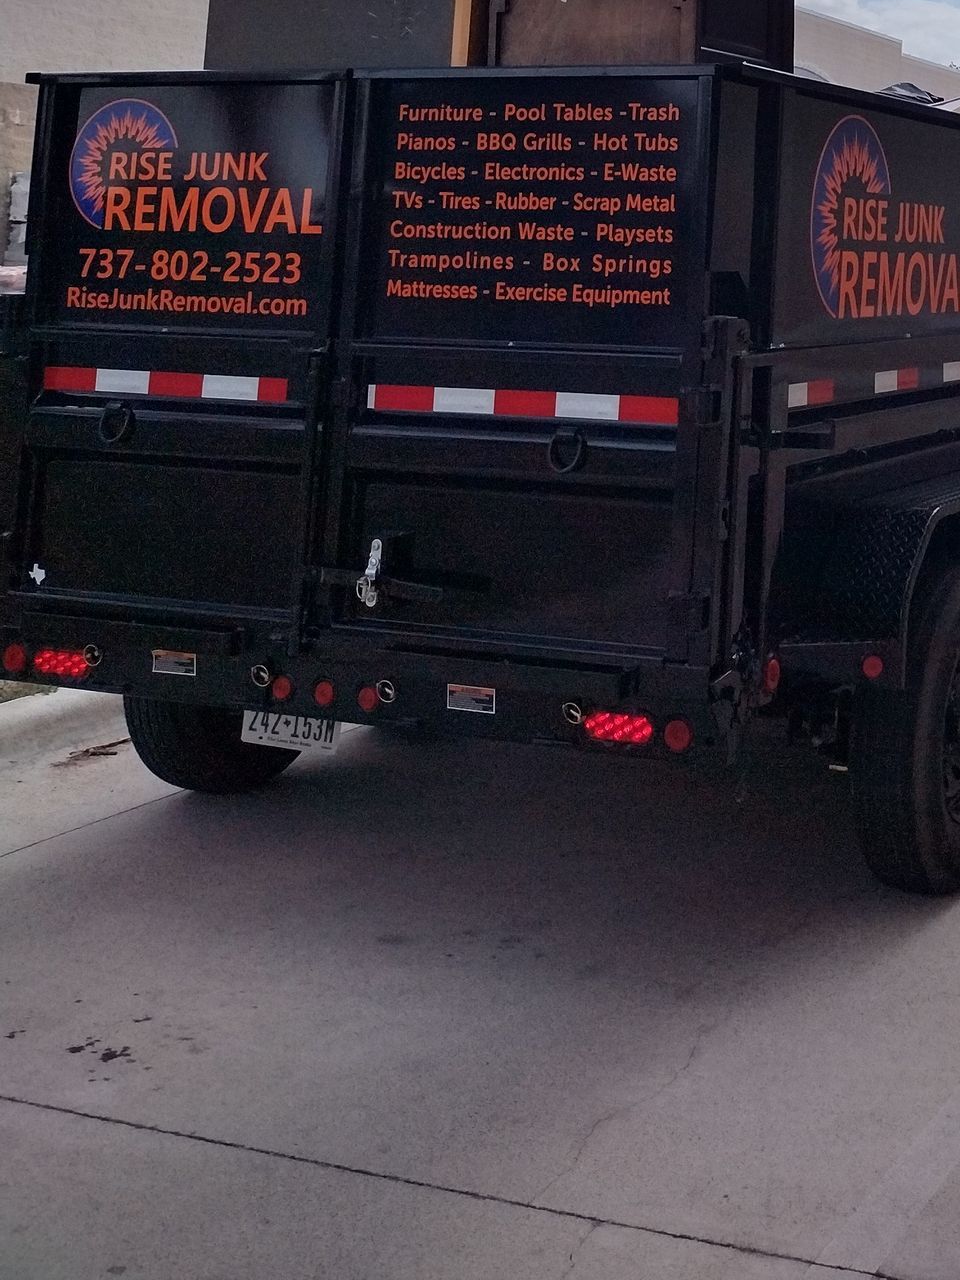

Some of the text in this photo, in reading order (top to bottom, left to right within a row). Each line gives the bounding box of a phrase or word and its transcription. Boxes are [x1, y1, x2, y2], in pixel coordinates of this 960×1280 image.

[399, 103, 483, 121] Furniture
[504, 103, 546, 121] Pool
[553, 103, 613, 121] Tables
[628, 102, 680, 121] Trash
[396, 132, 456, 150] Pianos
[476, 132, 516, 151] BBQ
[523, 132, 572, 151] Grills
[593, 132, 628, 151] Hot
[634, 132, 679, 151] Tubs
[108, 152, 269, 182] RISE JUNK
[394, 162, 466, 184] Bicycles
[484, 162, 585, 181] Electronics
[604, 163, 677, 181] E-Waste
[103, 186, 323, 235] REMOVAL
[392, 191, 423, 209] TVs
[439, 191, 480, 210] Tires
[495, 191, 557, 210] Rubber
[573, 192, 621, 216] Scrap
[625, 193, 676, 212] Metal
[390, 220, 511, 240] Construction
[518, 222, 574, 241] Waste
[596, 223, 673, 247] Playsets
[843, 197, 945, 244] RISE JUNK
[79, 248, 302, 285] 737-802-2523
[388, 249, 514, 273] Trampolines
[543, 252, 581, 271] Box
[592, 253, 672, 278] Springs
[66, 286, 307, 316] RiseJunkRemoval.com
[387, 279, 478, 300] Mattresses
[495, 281, 567, 302] Exercise
[572, 283, 671, 308] Equipment
